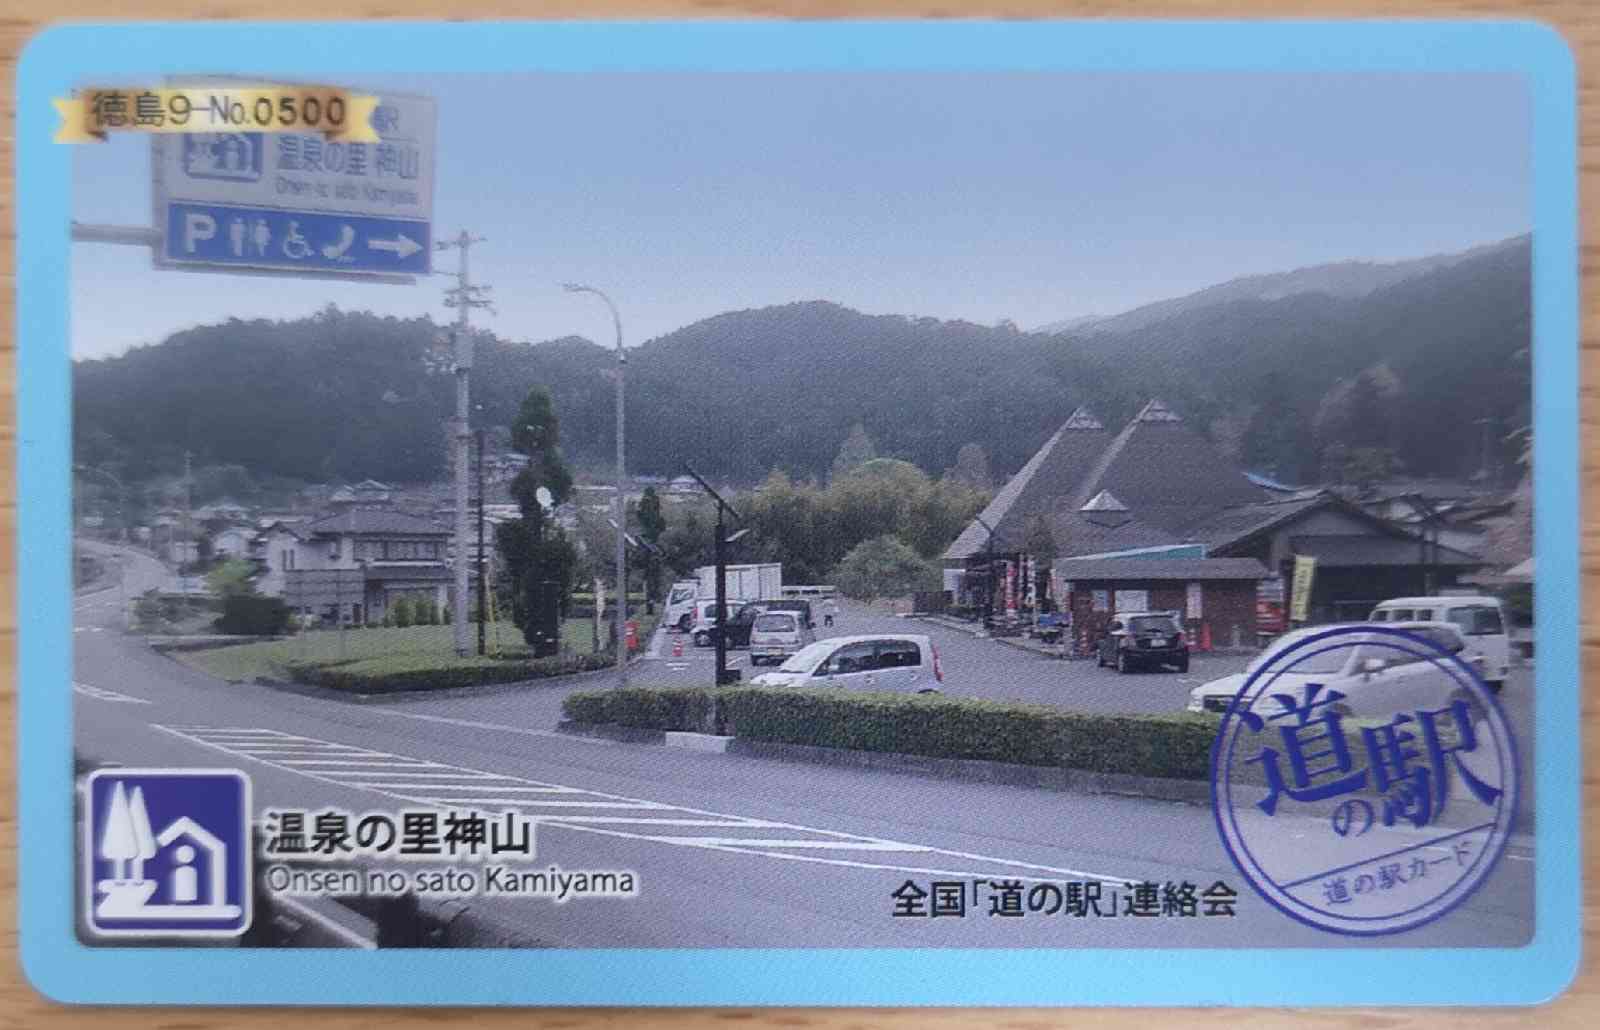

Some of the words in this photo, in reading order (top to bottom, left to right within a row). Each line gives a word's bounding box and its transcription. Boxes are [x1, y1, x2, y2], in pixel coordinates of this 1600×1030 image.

[183, 215, 217, 253] P
[265, 811, 531, 855] 温泉の里神山
[268, 865, 358, 892] Onsen
[369, 872, 406, 892] no
[415, 869, 475, 892] sato
[485, 866, 635, 899] Kamiyama
[1321, 841, 1471, 906] 道の駅カード
[891, 880, 1238, 918] 全国「道の駅」連絡会
